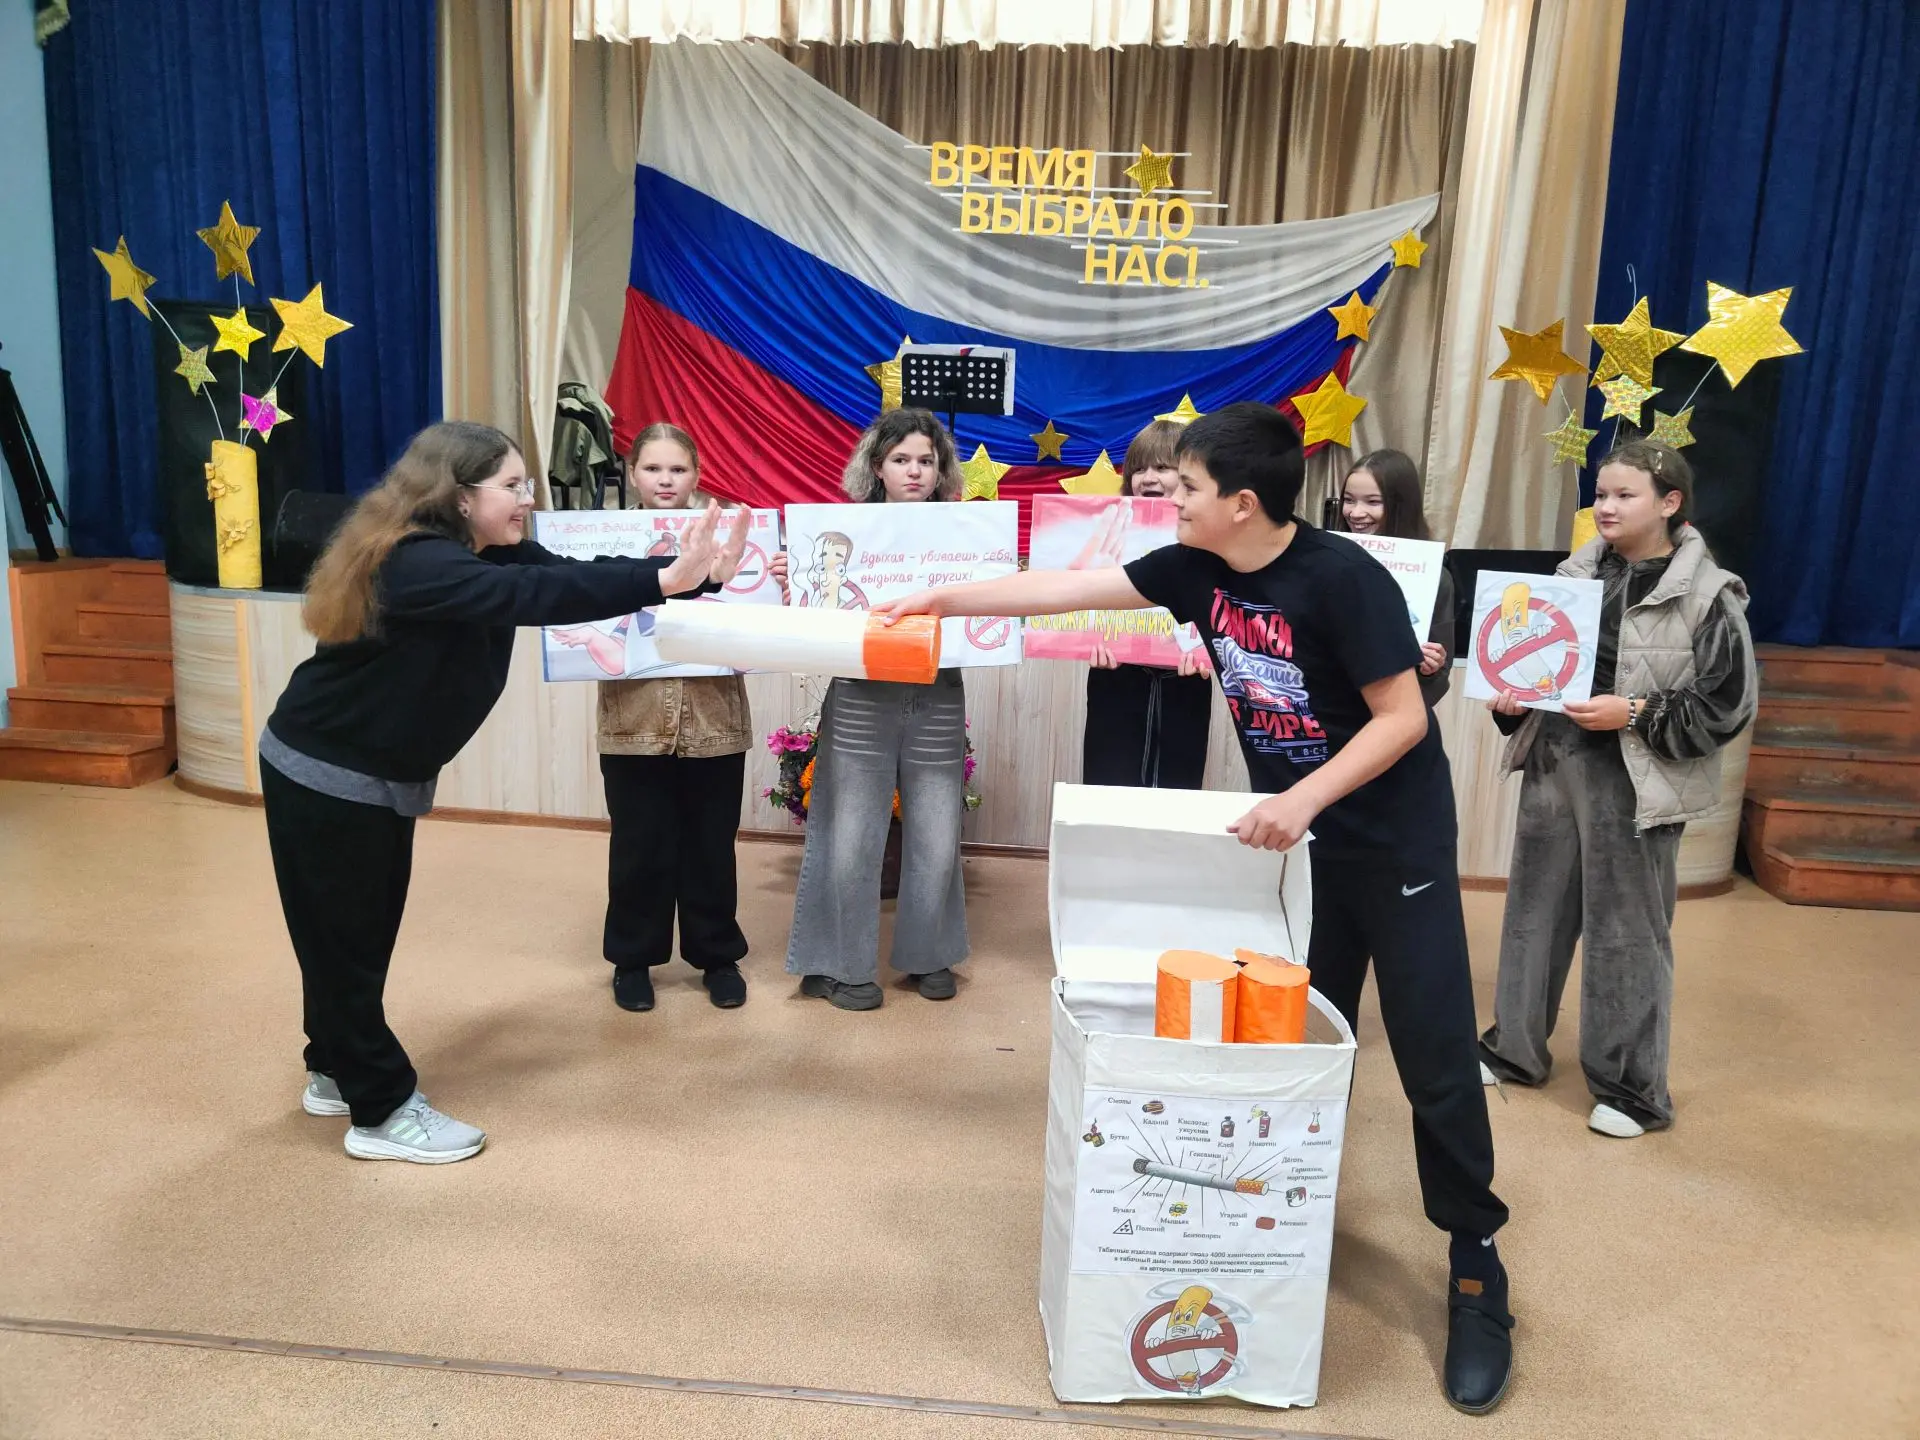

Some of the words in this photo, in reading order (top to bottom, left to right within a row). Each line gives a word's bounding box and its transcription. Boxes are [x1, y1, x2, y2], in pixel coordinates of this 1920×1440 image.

[930, 141, 1094, 192] ВРЕМЯ
[960, 193, 1194, 241] ВЫБРАЛО
[860, 551, 905, 568] Вдыхая
[920, 550, 979, 568] убиваешь
[983, 549, 1013, 564] себя,
[860, 574, 914, 588] выдыхая
[928, 570, 973, 588] других!
